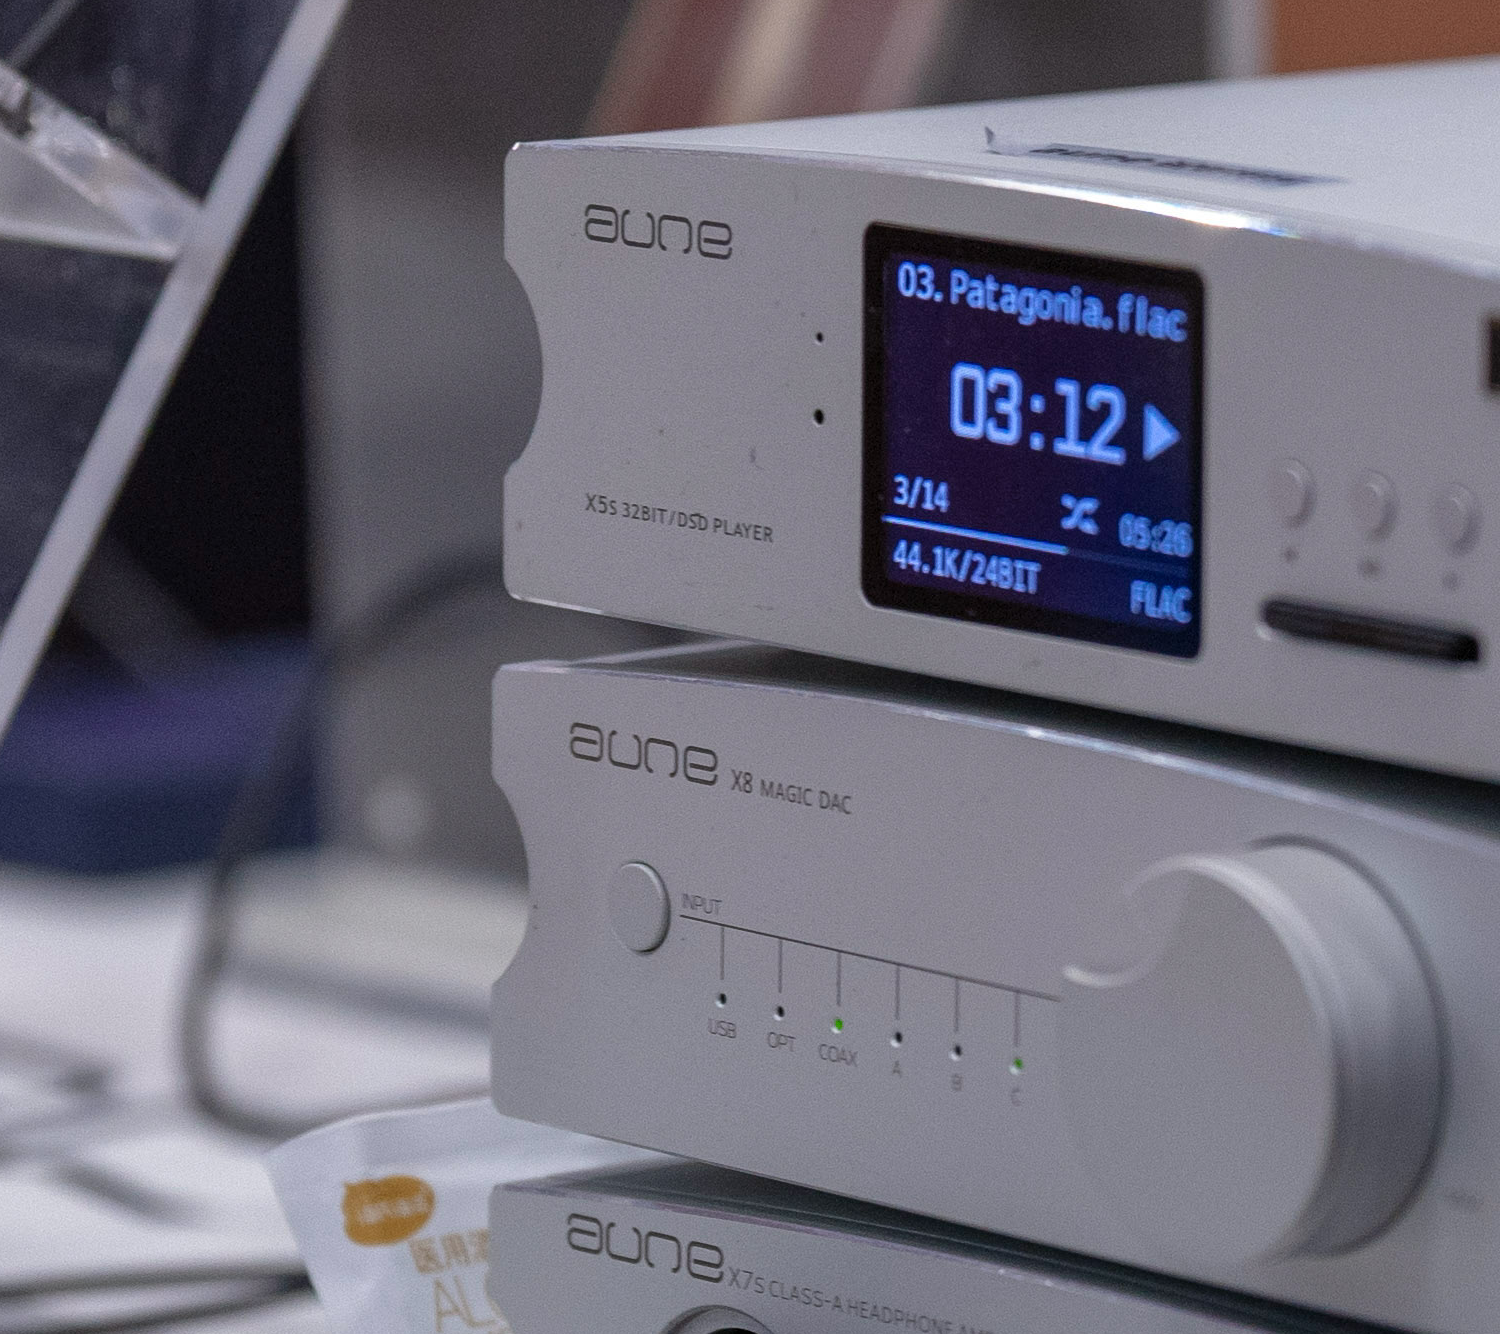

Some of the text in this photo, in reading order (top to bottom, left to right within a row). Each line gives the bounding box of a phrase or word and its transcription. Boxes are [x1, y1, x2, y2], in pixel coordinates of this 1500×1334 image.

[584, 203, 733, 261] aune
[950, 361, 1128, 467] 03:12
[892, 473, 951, 513] 3/14
[712, 517, 774, 544] PLAYER
[892, 539, 1043, 595] 44.1K/24BIT
[1129, 579, 1194, 624] FLAC
[569, 721, 853, 815] aune X8 MAGIC DAC
[681, 893, 723, 915] INPUT
[707, 1017, 738, 1039] USB
[767, 1031, 797, 1053] OPT
[818, 1042, 859, 1068] COAX
[566, 1212, 725, 1284] aune
[768, 1280, 844, 1313] CLASS-A
